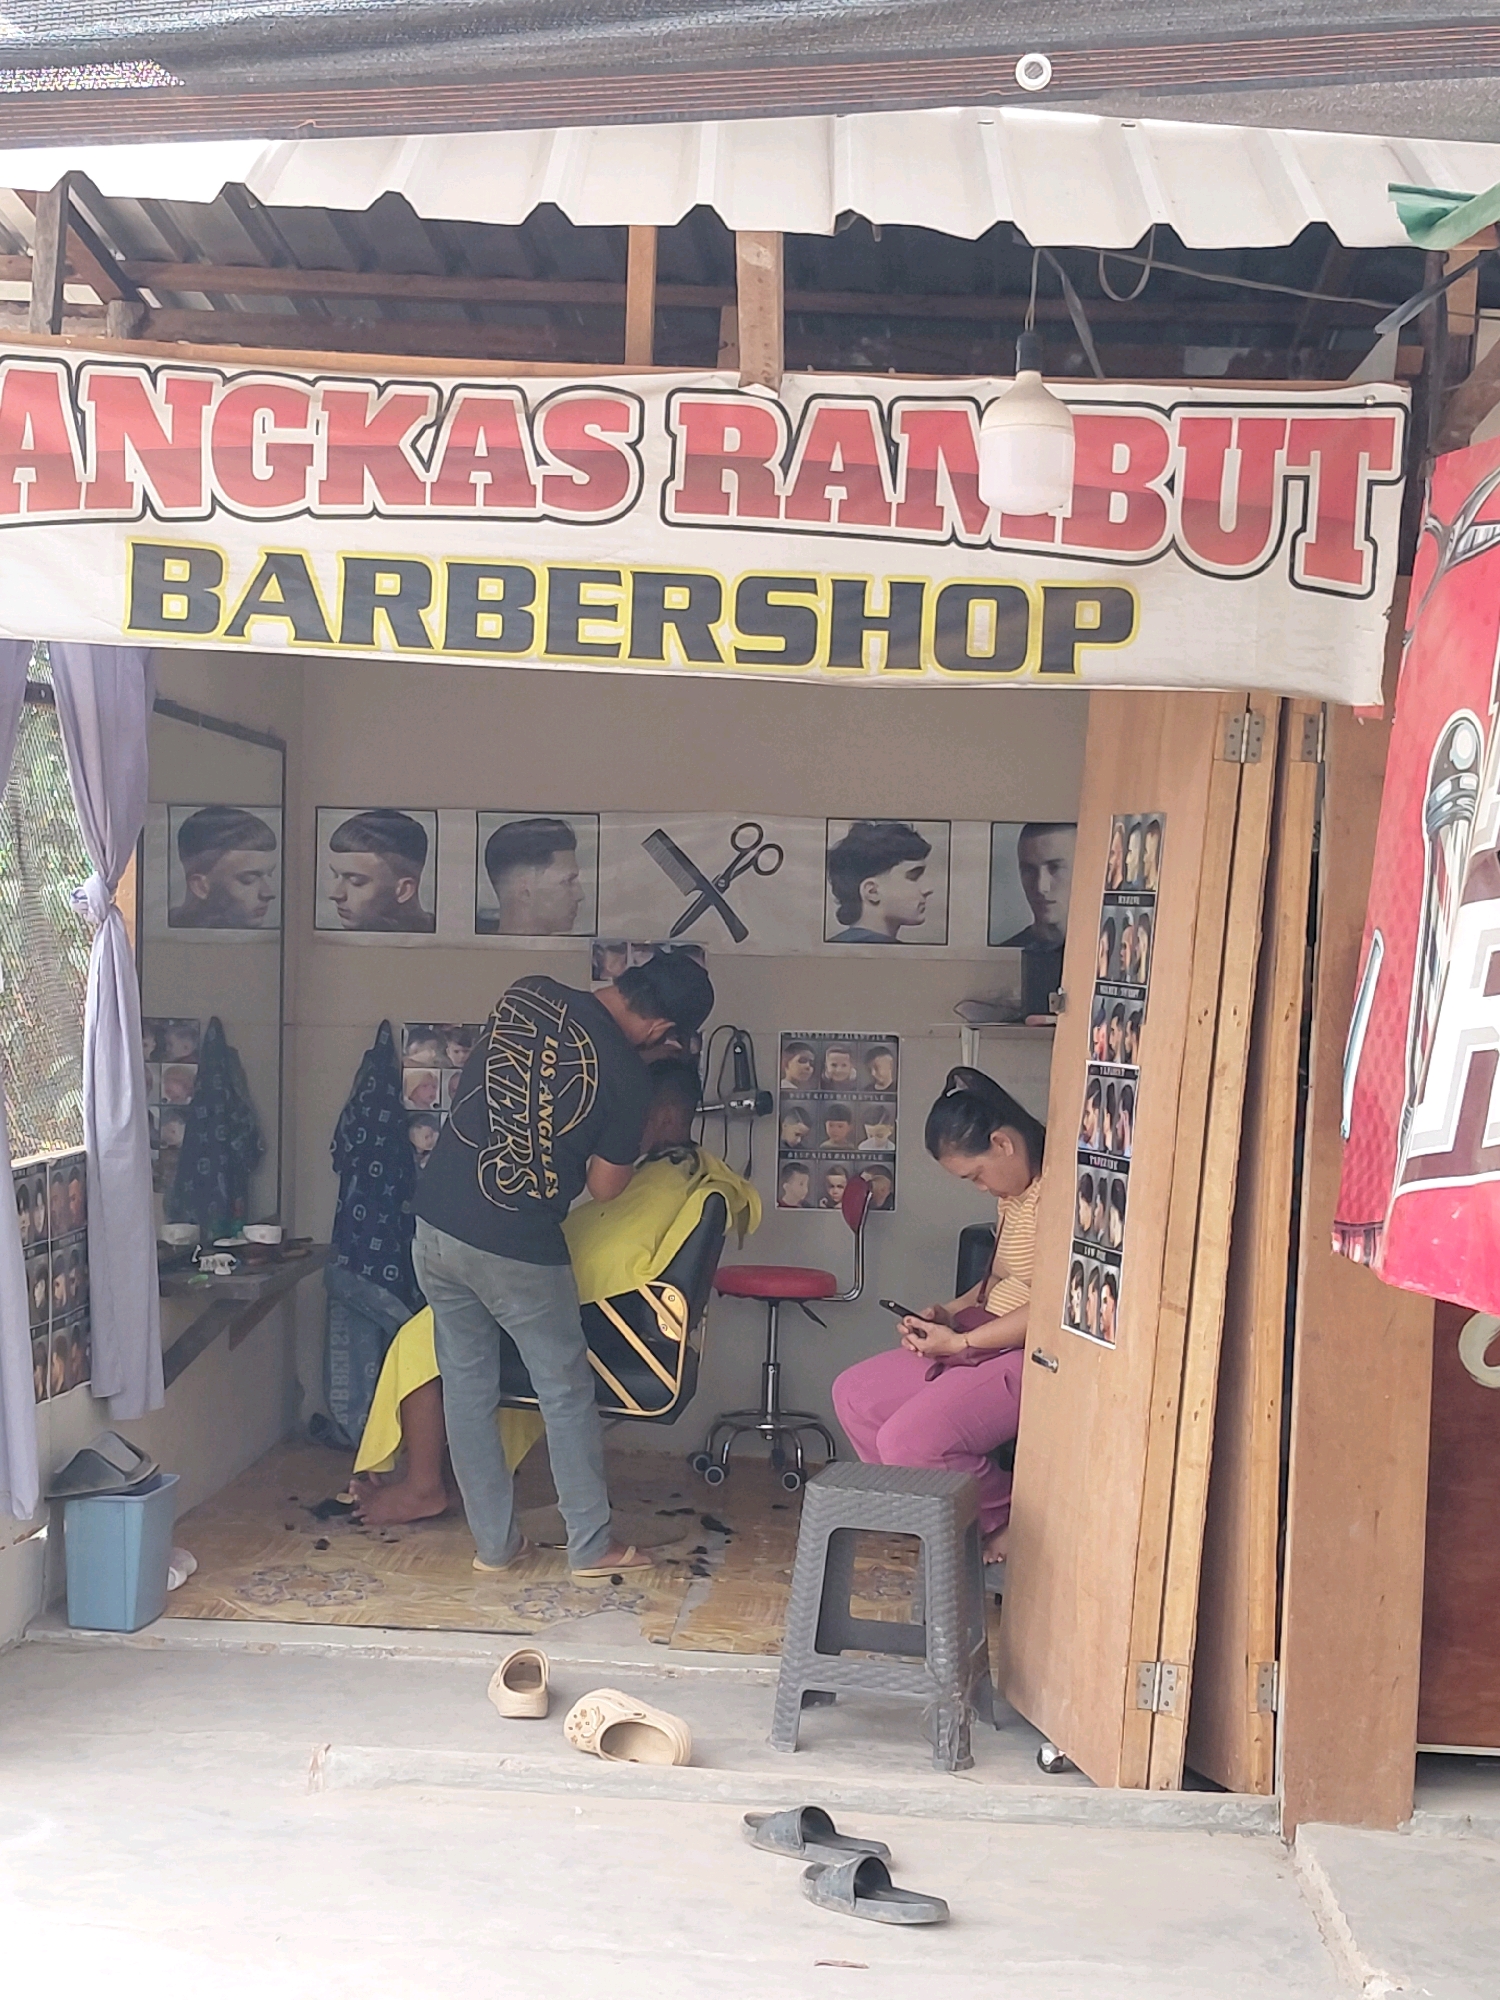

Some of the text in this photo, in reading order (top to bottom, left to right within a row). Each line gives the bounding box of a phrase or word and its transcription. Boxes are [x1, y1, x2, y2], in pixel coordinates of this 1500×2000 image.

[124, 535, 1140, 681] BARBERSHOP
[477, 986, 569, 1212] LAKERS
[536, 1035, 560, 1199] LOS ANGELES
